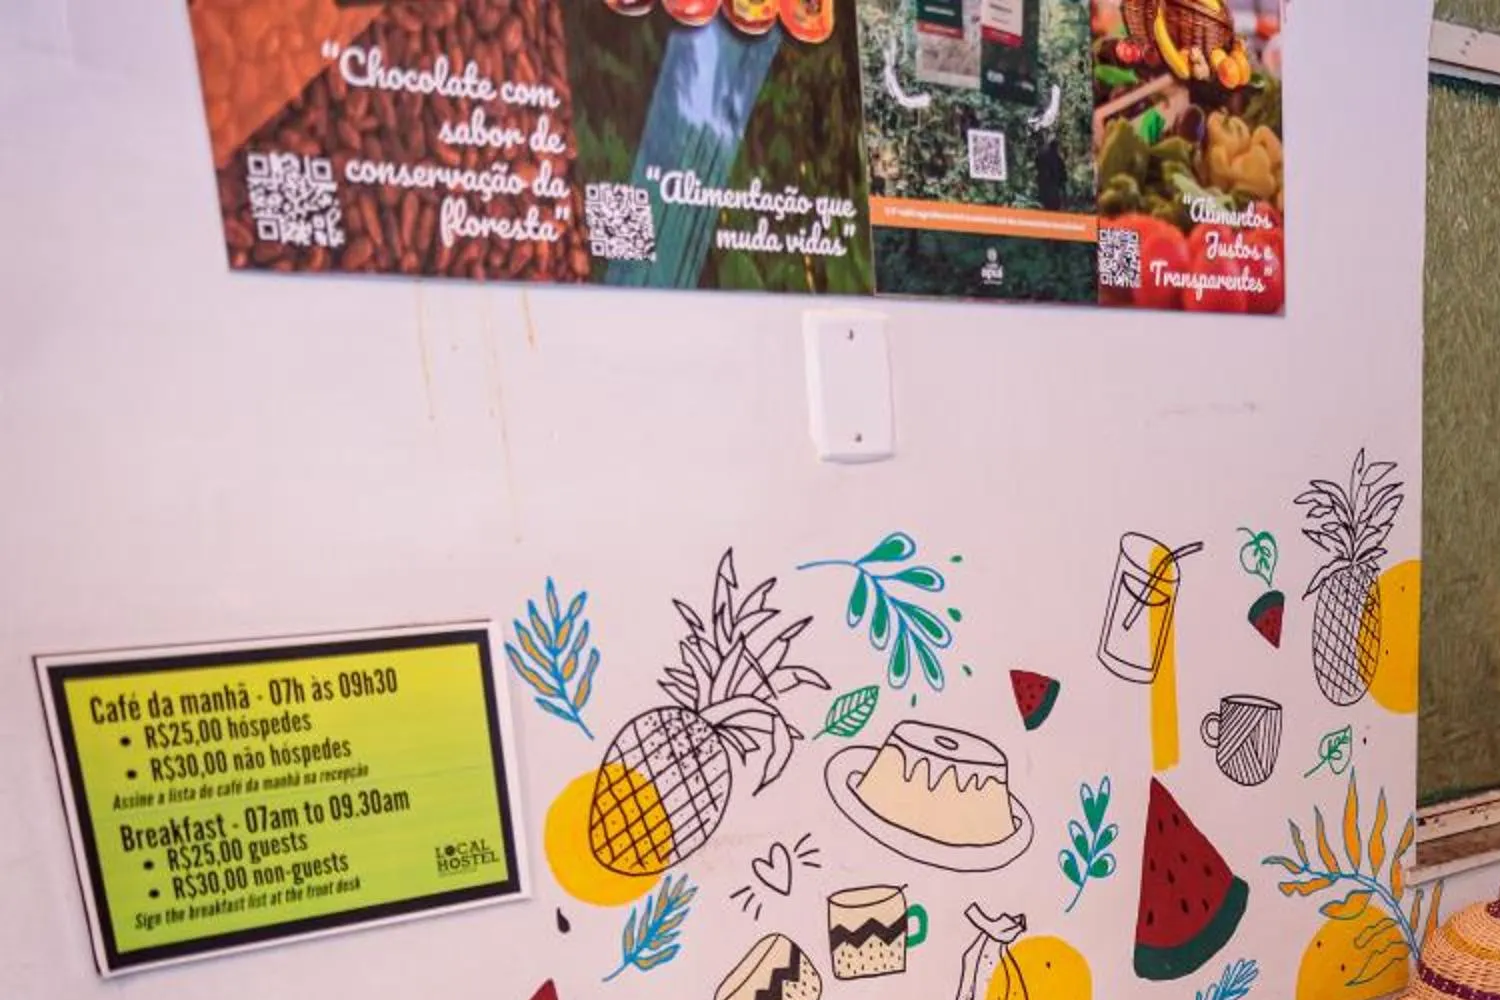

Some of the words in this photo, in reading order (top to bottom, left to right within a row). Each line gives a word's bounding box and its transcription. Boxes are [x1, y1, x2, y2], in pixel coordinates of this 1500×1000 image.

[501, 81, 561, 108] com
[437, 106, 526, 148] sabor
[529, 113, 566, 154] de
[345, 158, 528, 202] conservação
[531, 159, 571, 198] da
[815, 195, 857, 230] que
[716, 216, 784, 252] muda
[1205, 230, 1263, 260] Justos
[1263, 245, 1274, 260] e
[90, 691, 141, 725] Café
[147, 690, 175, 718] da
[179, 682, 250, 716] manhã
[269, 677, 305, 706] 07h
[311, 675, 335, 701] às
[338, 667, 399, 699] 09h30
[144, 717, 223, 750] R$25,00
[226, 710, 312, 740] hóspedes
[151, 750, 228, 783] R$30,00
[232, 747, 265, 771] não
[270, 737, 352, 768] hóspedes
[113, 793, 155, 811] Assine
[157, 792, 165, 805] a
[168, 787, 196, 802] lista
[199, 784, 214, 799] de
[217, 779, 243, 797] café
[245, 779, 260, 793] da
[263, 772, 300, 790] manhã
[303, 771, 317, 784] na
[319, 763, 370, 784] recepção
[119, 813, 227, 853] Breakfast
[244, 805, 300, 834] 07am
[304, 801, 325, 826] to
[328, 787, 411, 821] 09.30am
[166, 838, 243, 872] R$25,00
[248, 832, 309, 865] guests
[434, 838, 491, 859] LOCAL
[436, 850, 501, 873] HOSTEL
[172, 866, 249, 900] R$30,00
[253, 852, 349, 887] non-guests
[135, 912, 161, 930] Sign
[165, 907, 186, 924] the
[189, 899, 246, 921] breakfast
[248, 895, 269, 914] list
[270, 893, 282, 908] at
[285, 886, 304, 902] the
[306, 879, 334, 898] front
[336, 875, 361, 892] desk
